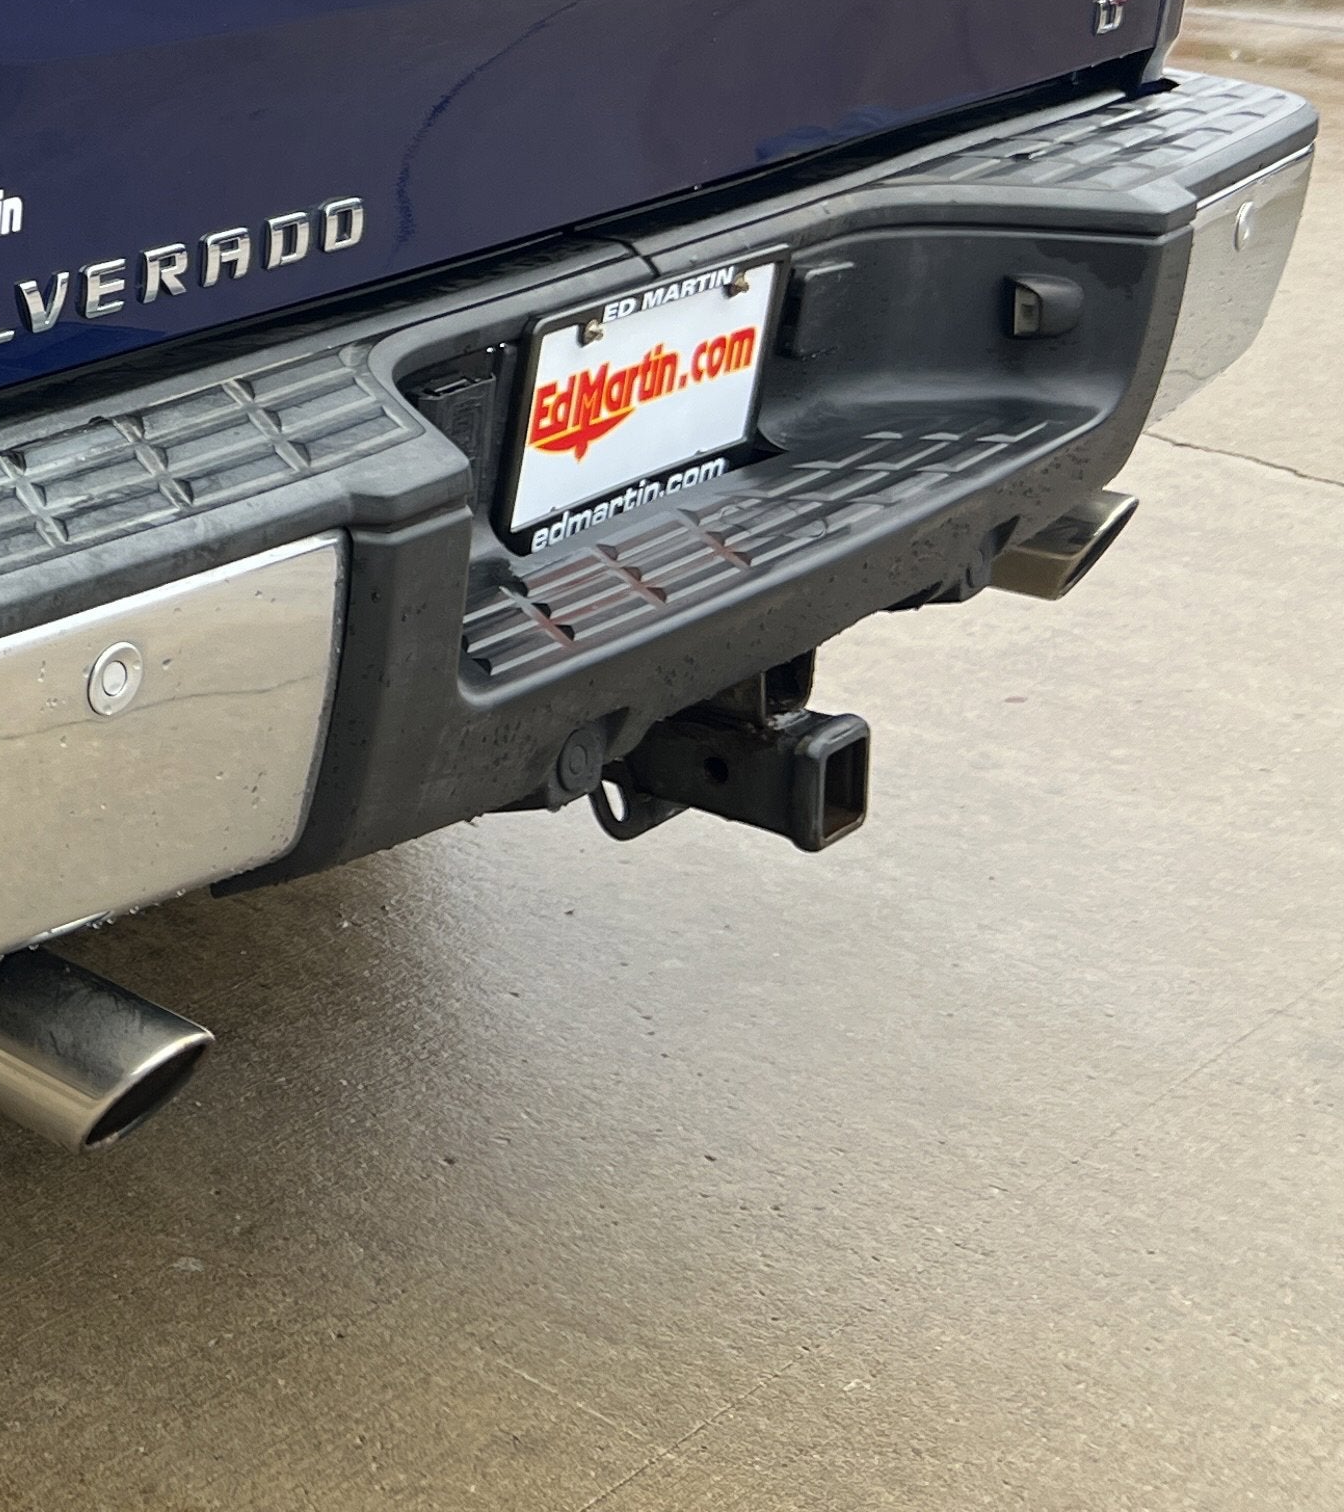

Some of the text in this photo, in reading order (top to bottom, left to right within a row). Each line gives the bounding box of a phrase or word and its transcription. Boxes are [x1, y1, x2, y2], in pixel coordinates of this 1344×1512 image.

[602, 265, 736, 323] ED MARTIN
[528, 326, 758, 448] EdMartin.com
[530, 457, 726, 554] edmartin.com
